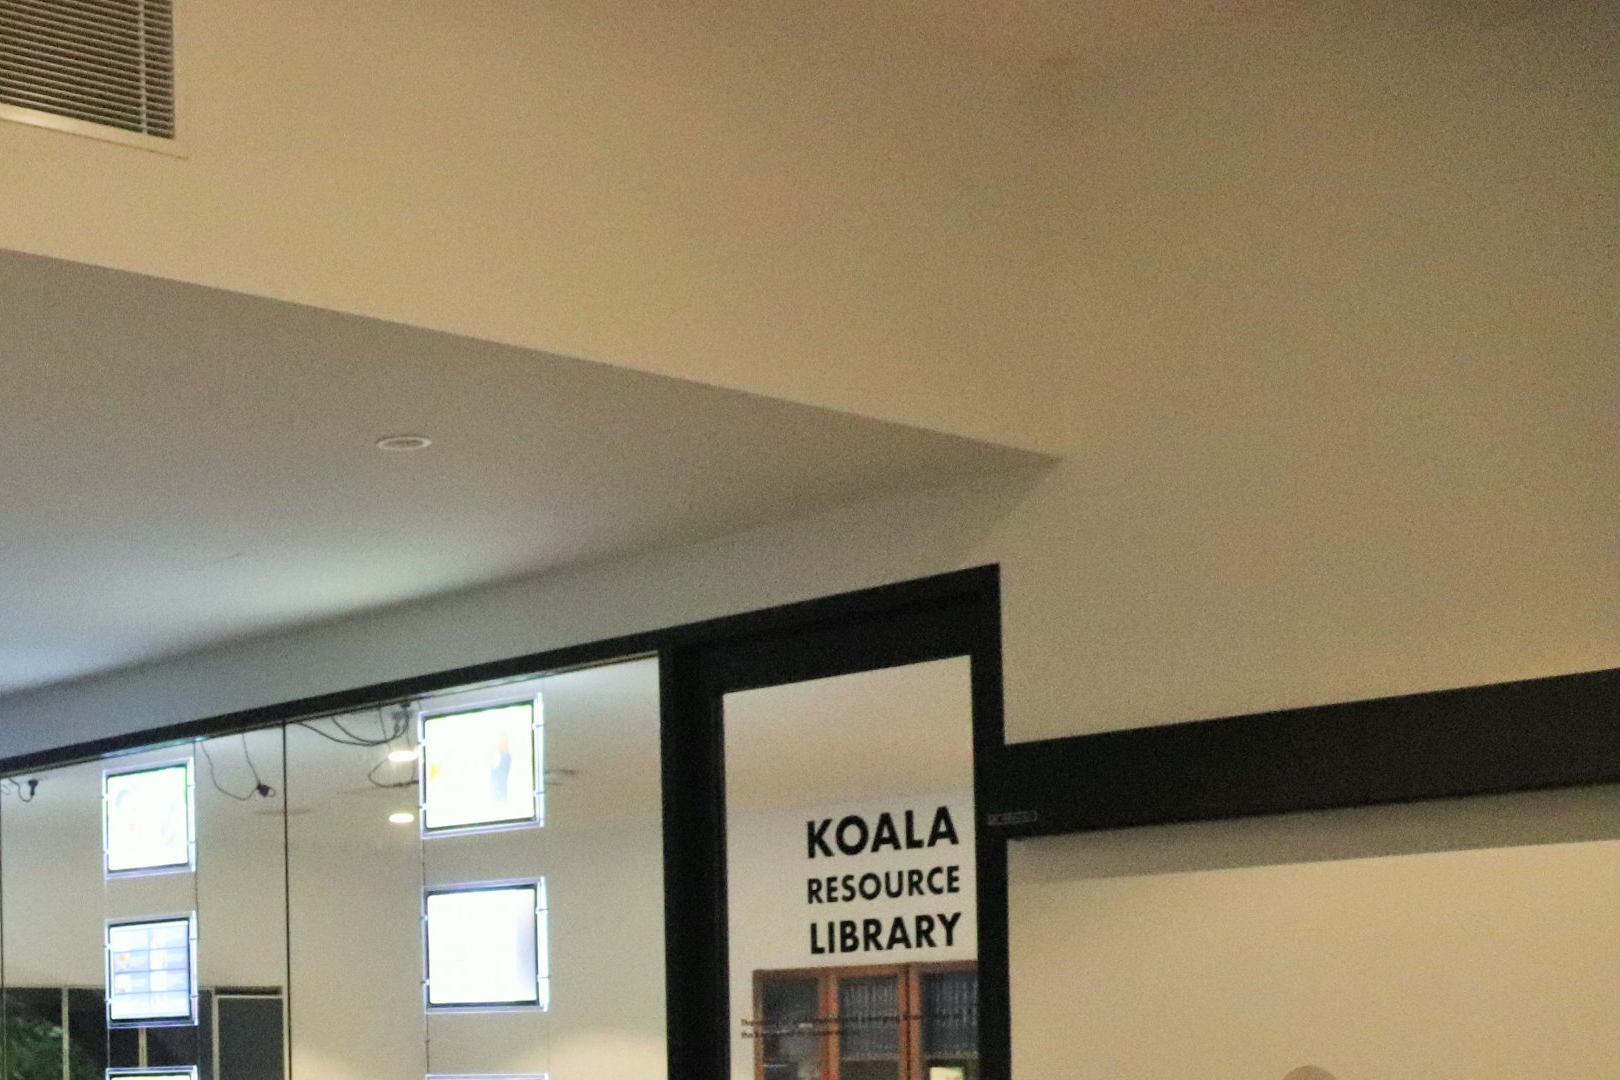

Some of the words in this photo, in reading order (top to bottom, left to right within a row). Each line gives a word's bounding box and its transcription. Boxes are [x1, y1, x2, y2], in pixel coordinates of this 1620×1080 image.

[807, 806, 959, 858] KOALA
[808, 865, 961, 905] RESOURCE
[810, 912, 962, 955] LIBRARY
